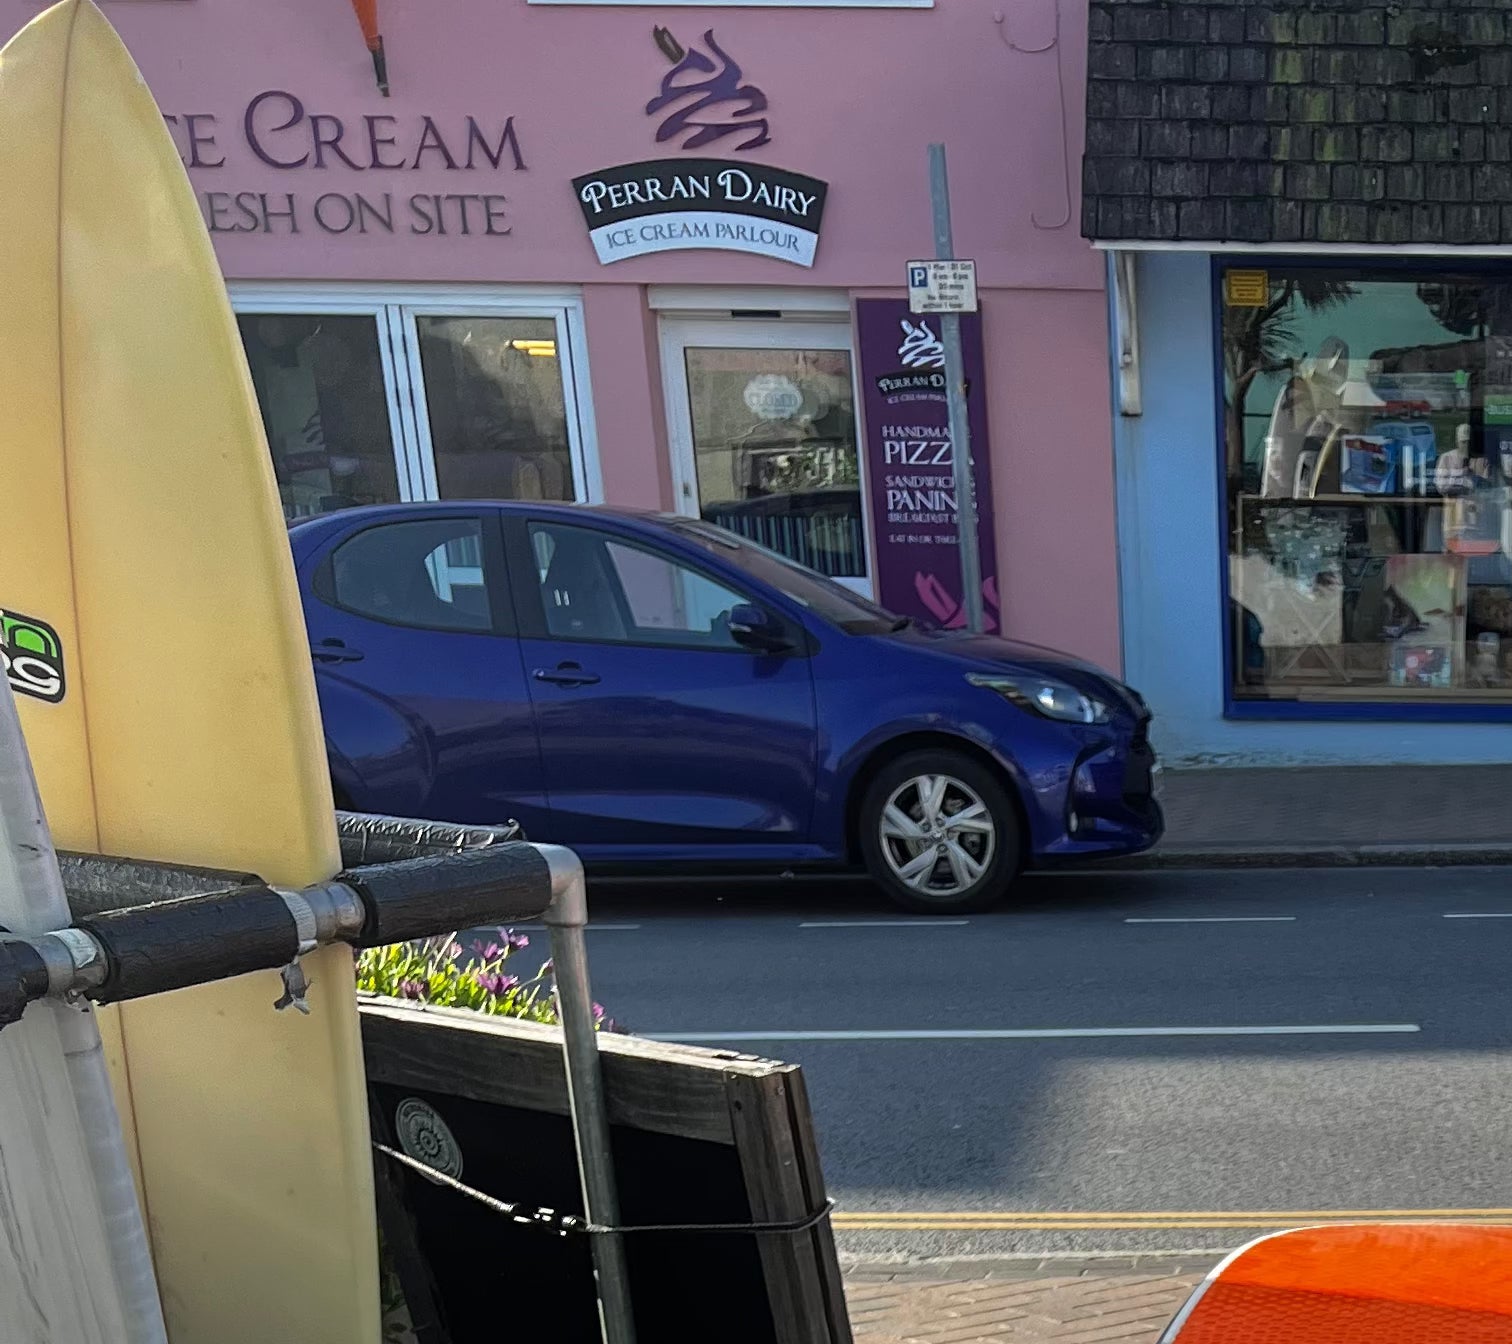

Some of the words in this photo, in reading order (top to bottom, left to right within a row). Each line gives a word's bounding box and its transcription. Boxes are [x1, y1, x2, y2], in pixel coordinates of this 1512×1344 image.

[581, 175, 710, 214] PERRAN
[717, 168, 816, 216] DAIRY
[205, 191, 301, 234] ESH
[313, 192, 394, 234] ON
[408, 193, 512, 236] SITE
[606, 228, 637, 249] ICE
[640, 222, 710, 242] CREAM
[715, 223, 800, 252] PARLOUR
[913, 268, 926, 286] P
[882, 425, 953, 438] HANDMA
[884, 440, 975, 465] PIZZ
